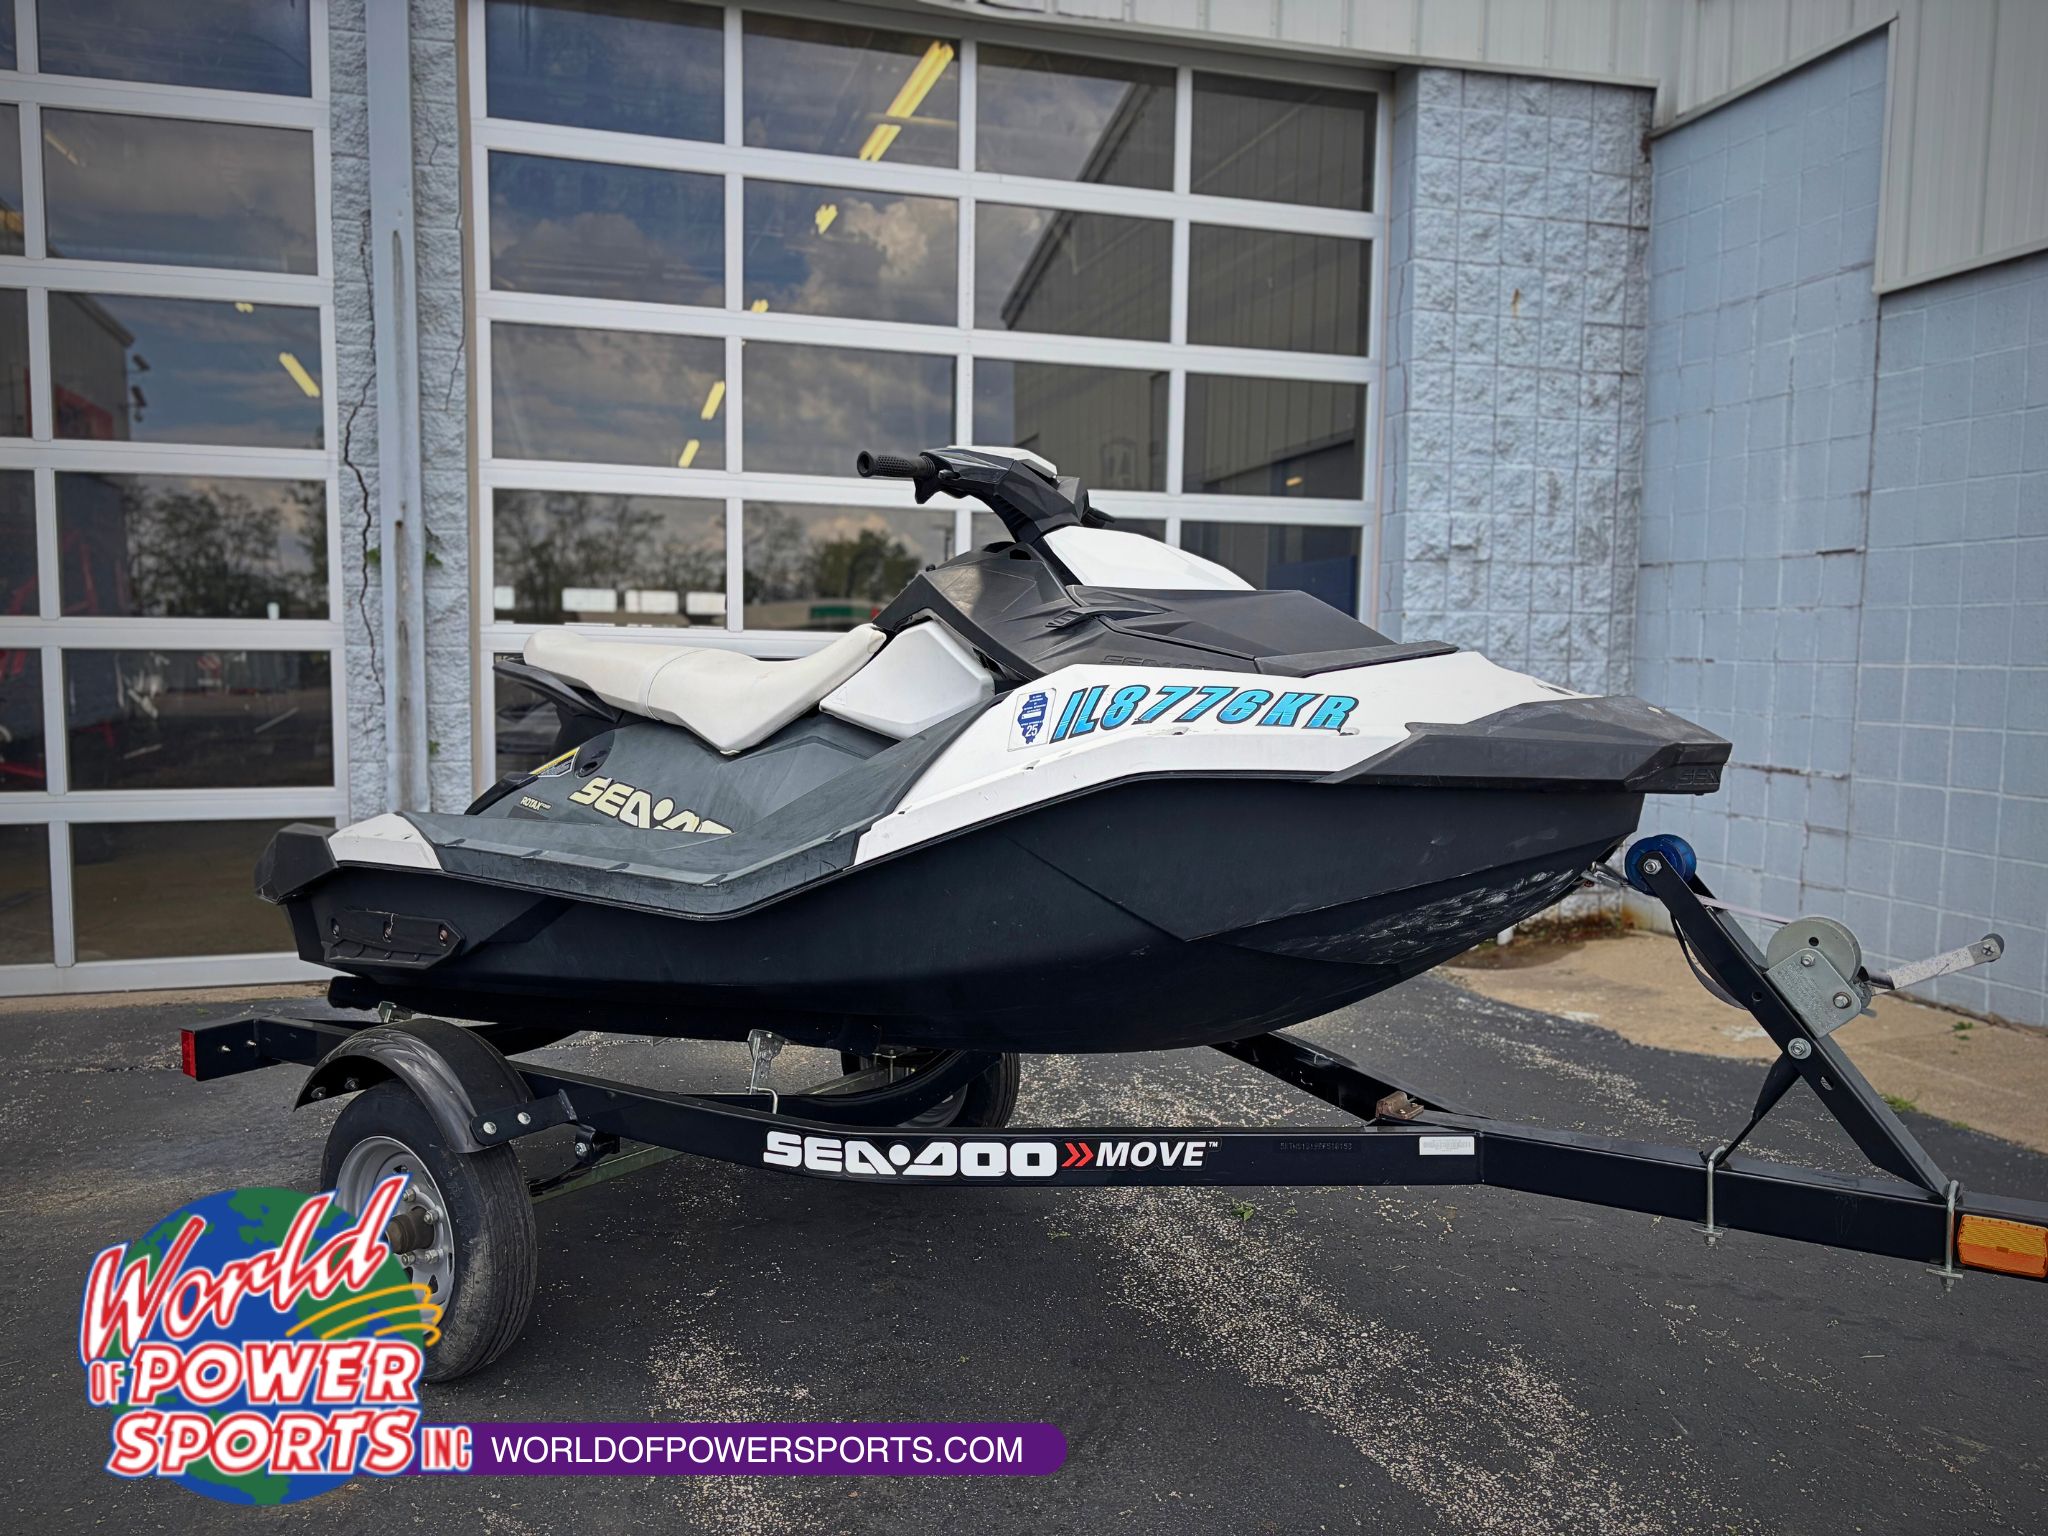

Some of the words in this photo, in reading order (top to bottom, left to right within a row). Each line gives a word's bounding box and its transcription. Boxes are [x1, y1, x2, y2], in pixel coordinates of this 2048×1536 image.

[1049, 684, 1359, 743] IL8776KR
[1025, 724, 1039, 737] 25
[520, 796, 541, 811] ROTAX
[1095, 1141, 1207, 1167] MOVE
